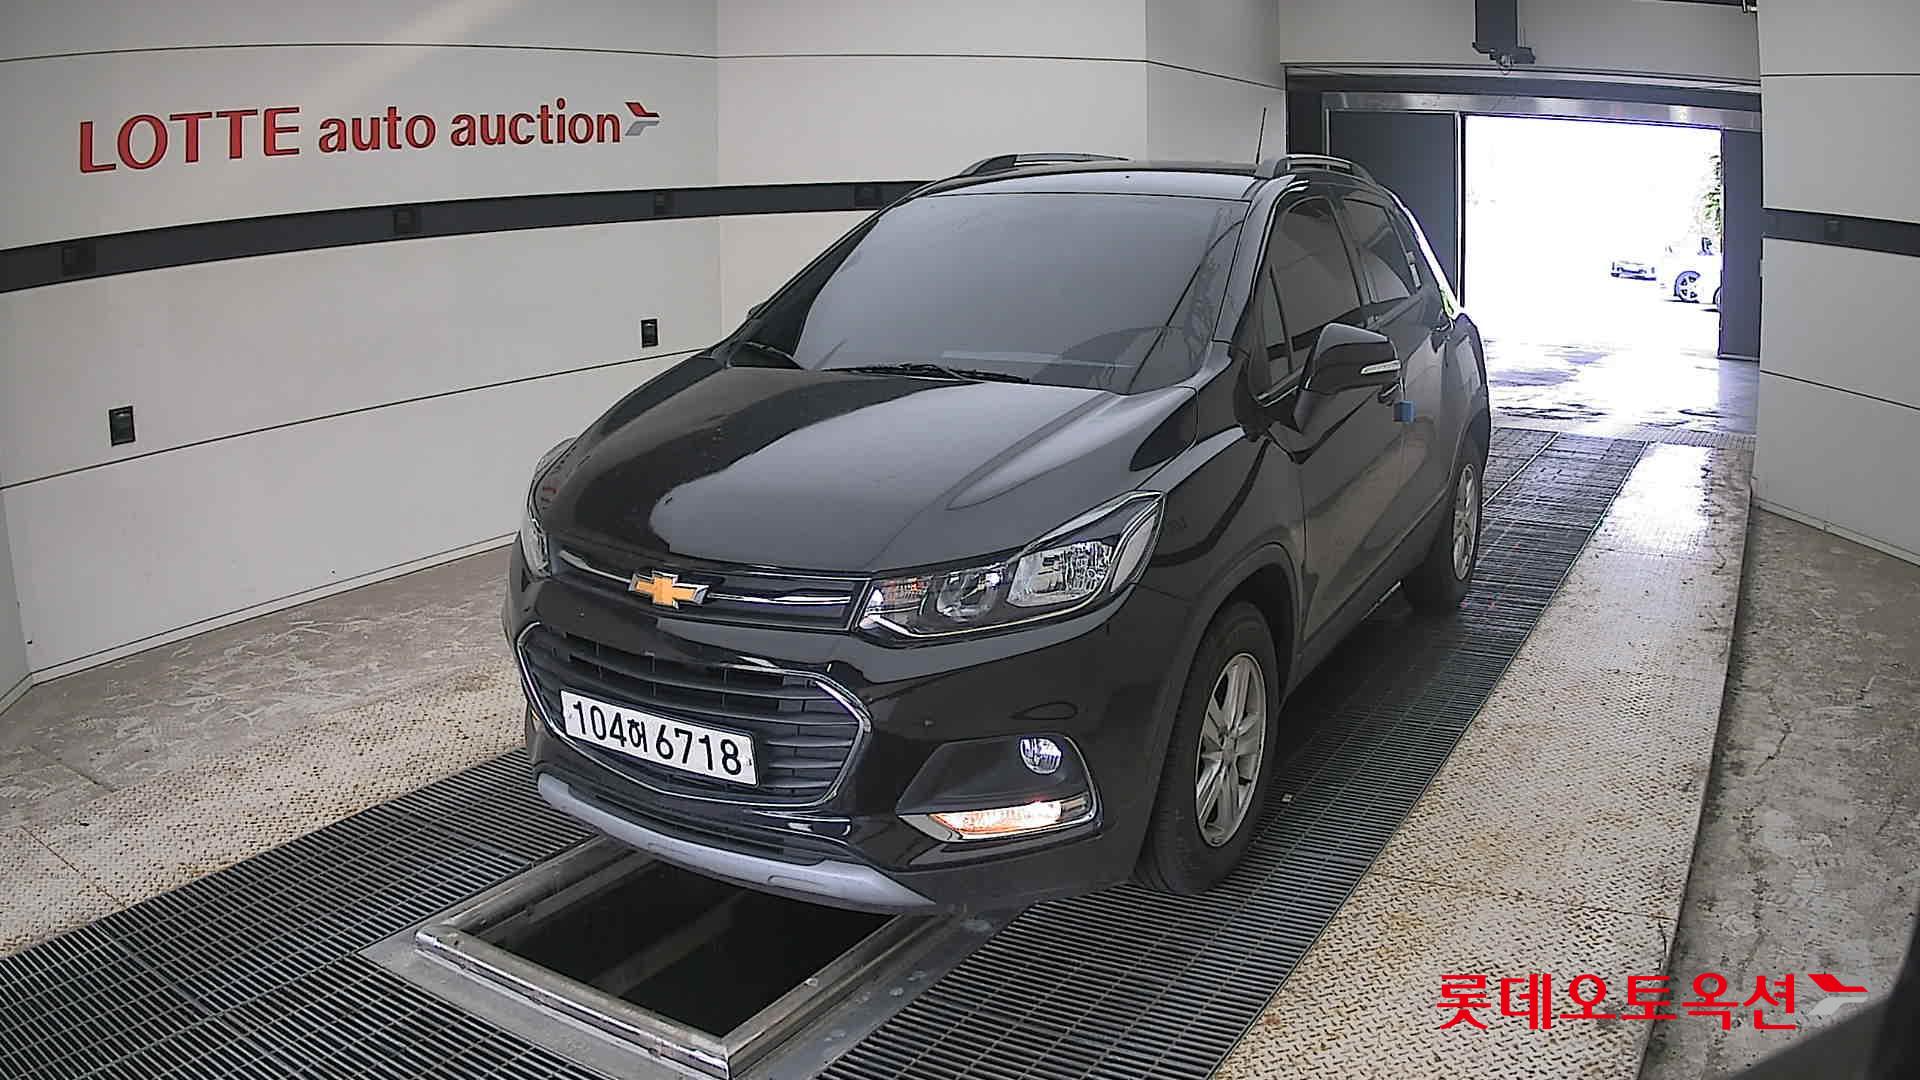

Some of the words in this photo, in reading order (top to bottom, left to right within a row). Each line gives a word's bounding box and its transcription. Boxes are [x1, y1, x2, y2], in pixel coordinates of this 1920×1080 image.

[79, 106, 301, 173] LOTTE
[318, 105, 436, 153] auto
[450, 97, 622, 147] auction
